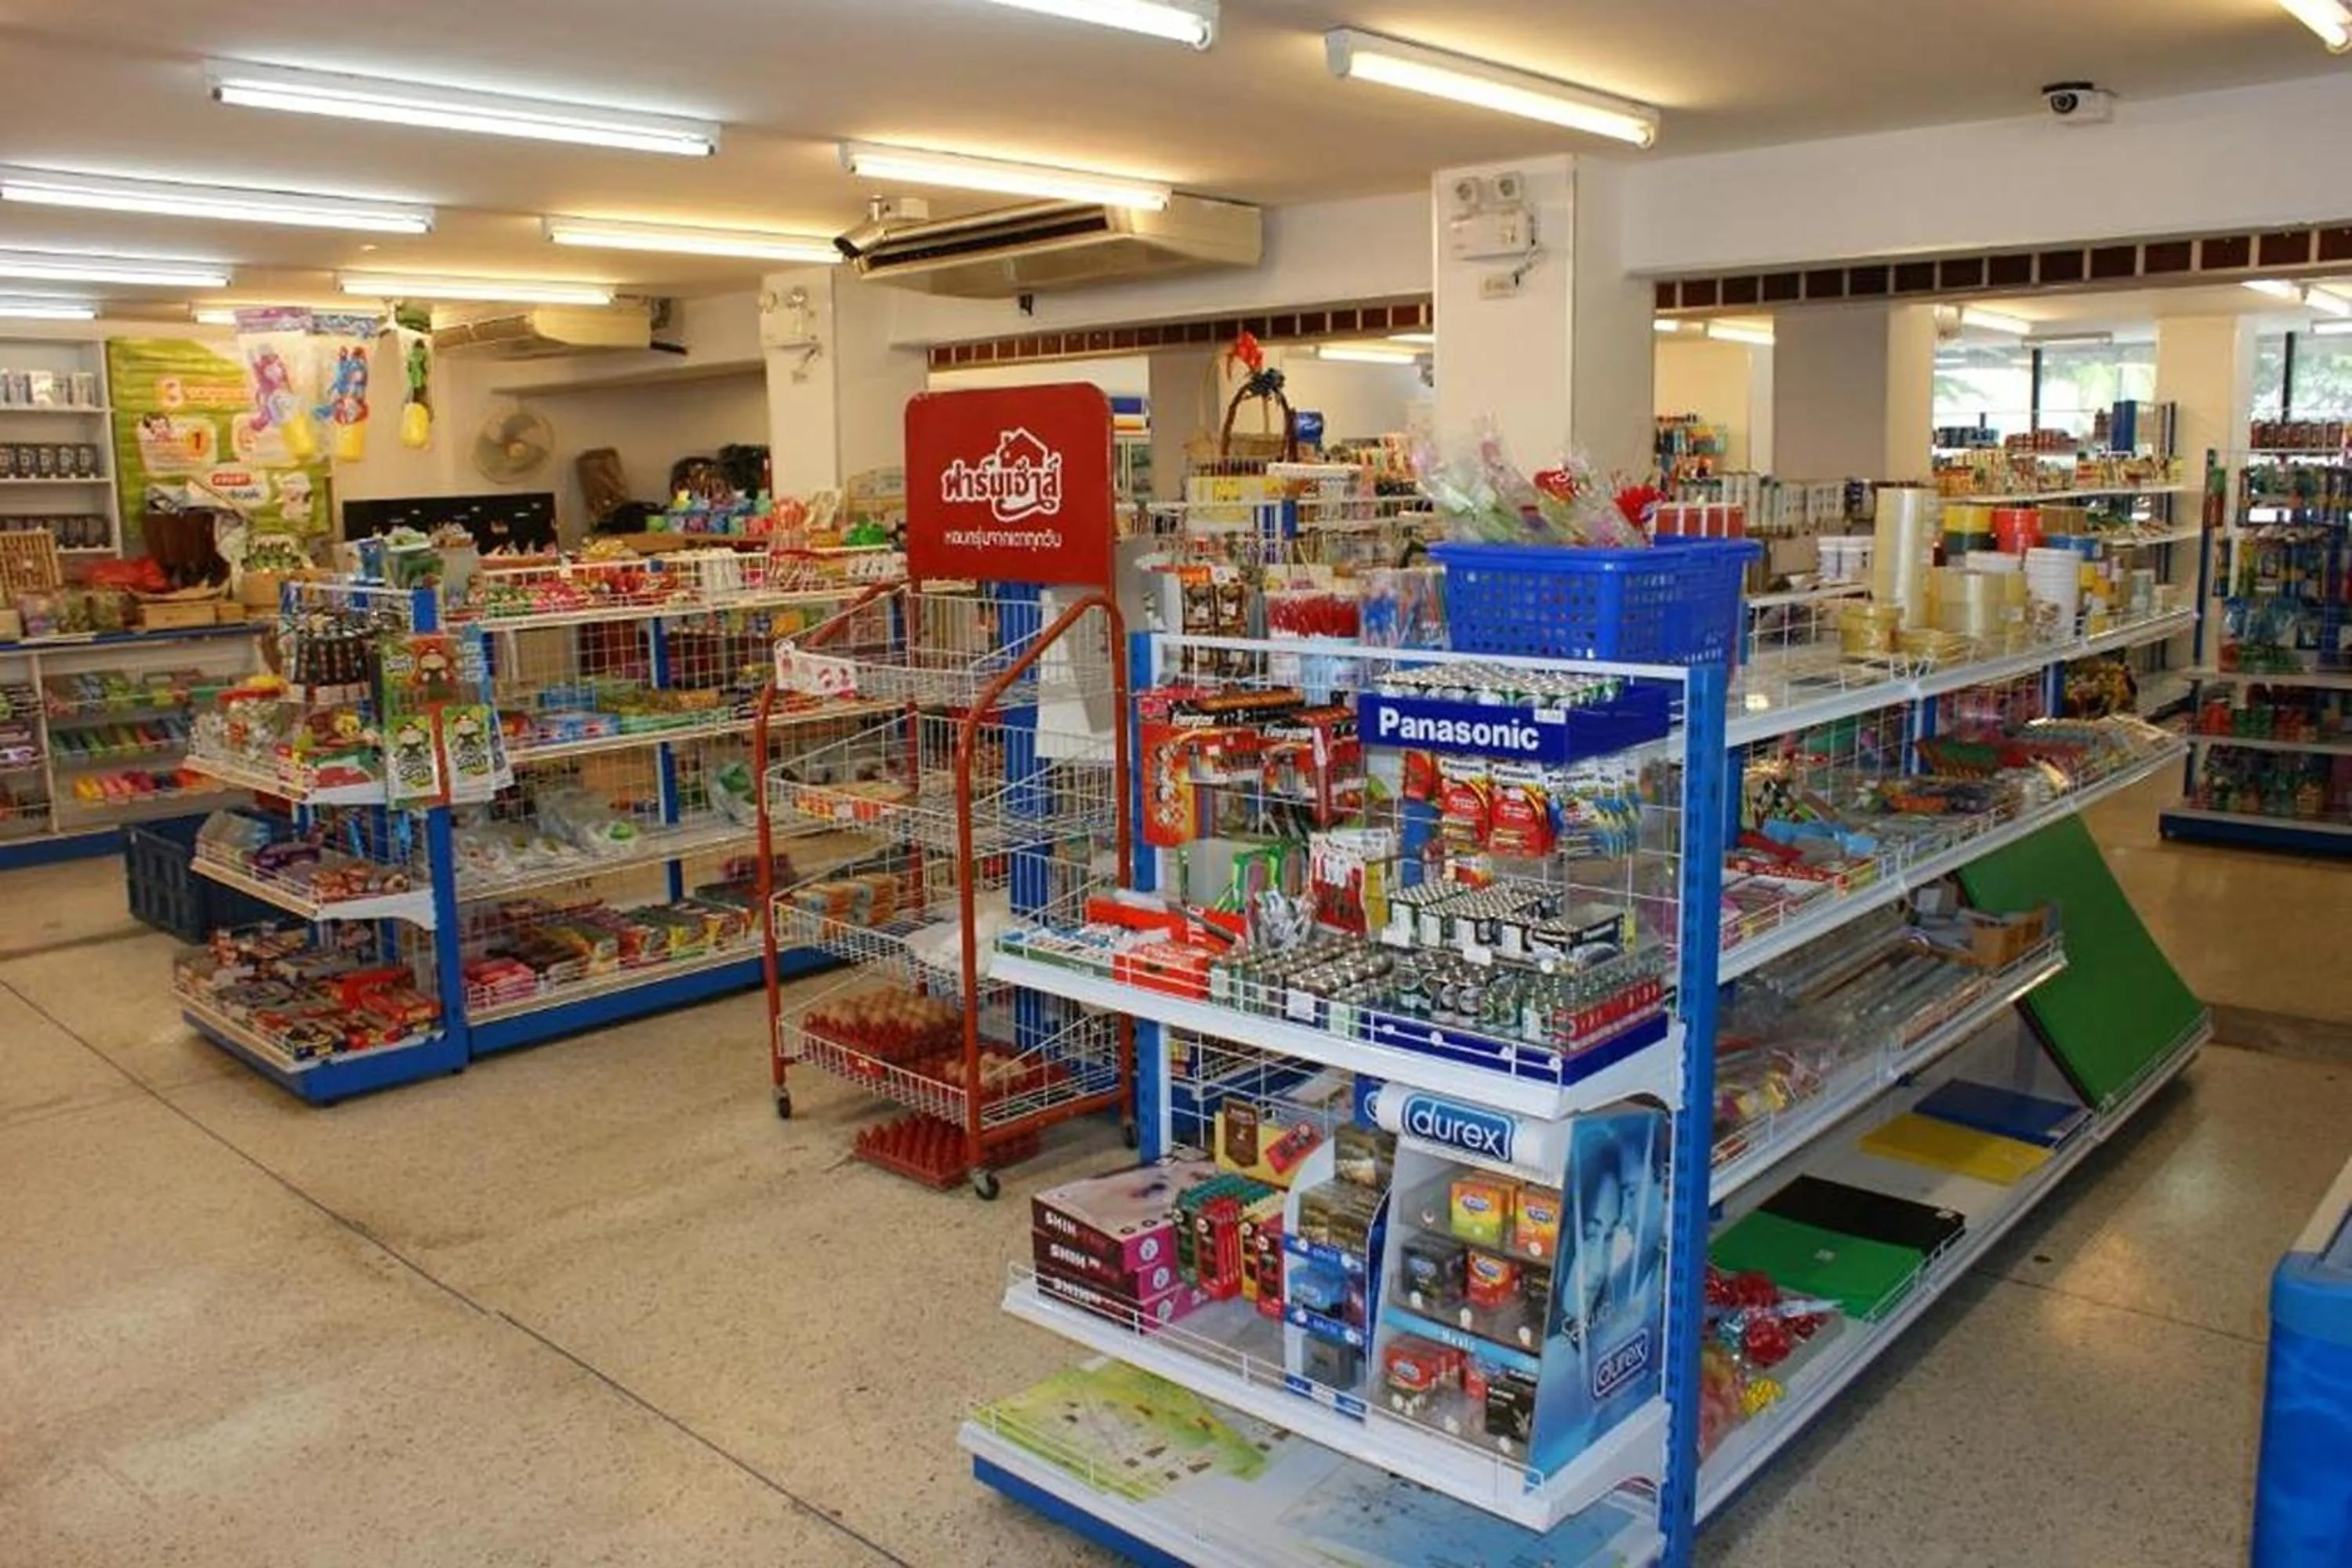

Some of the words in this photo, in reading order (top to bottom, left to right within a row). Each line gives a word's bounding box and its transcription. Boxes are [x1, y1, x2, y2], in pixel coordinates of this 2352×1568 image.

[1378, 706, 1540, 750] Panasonic
[1412, 1102, 1503, 1152] durex
[1598, 1341, 1646, 1386] durex
